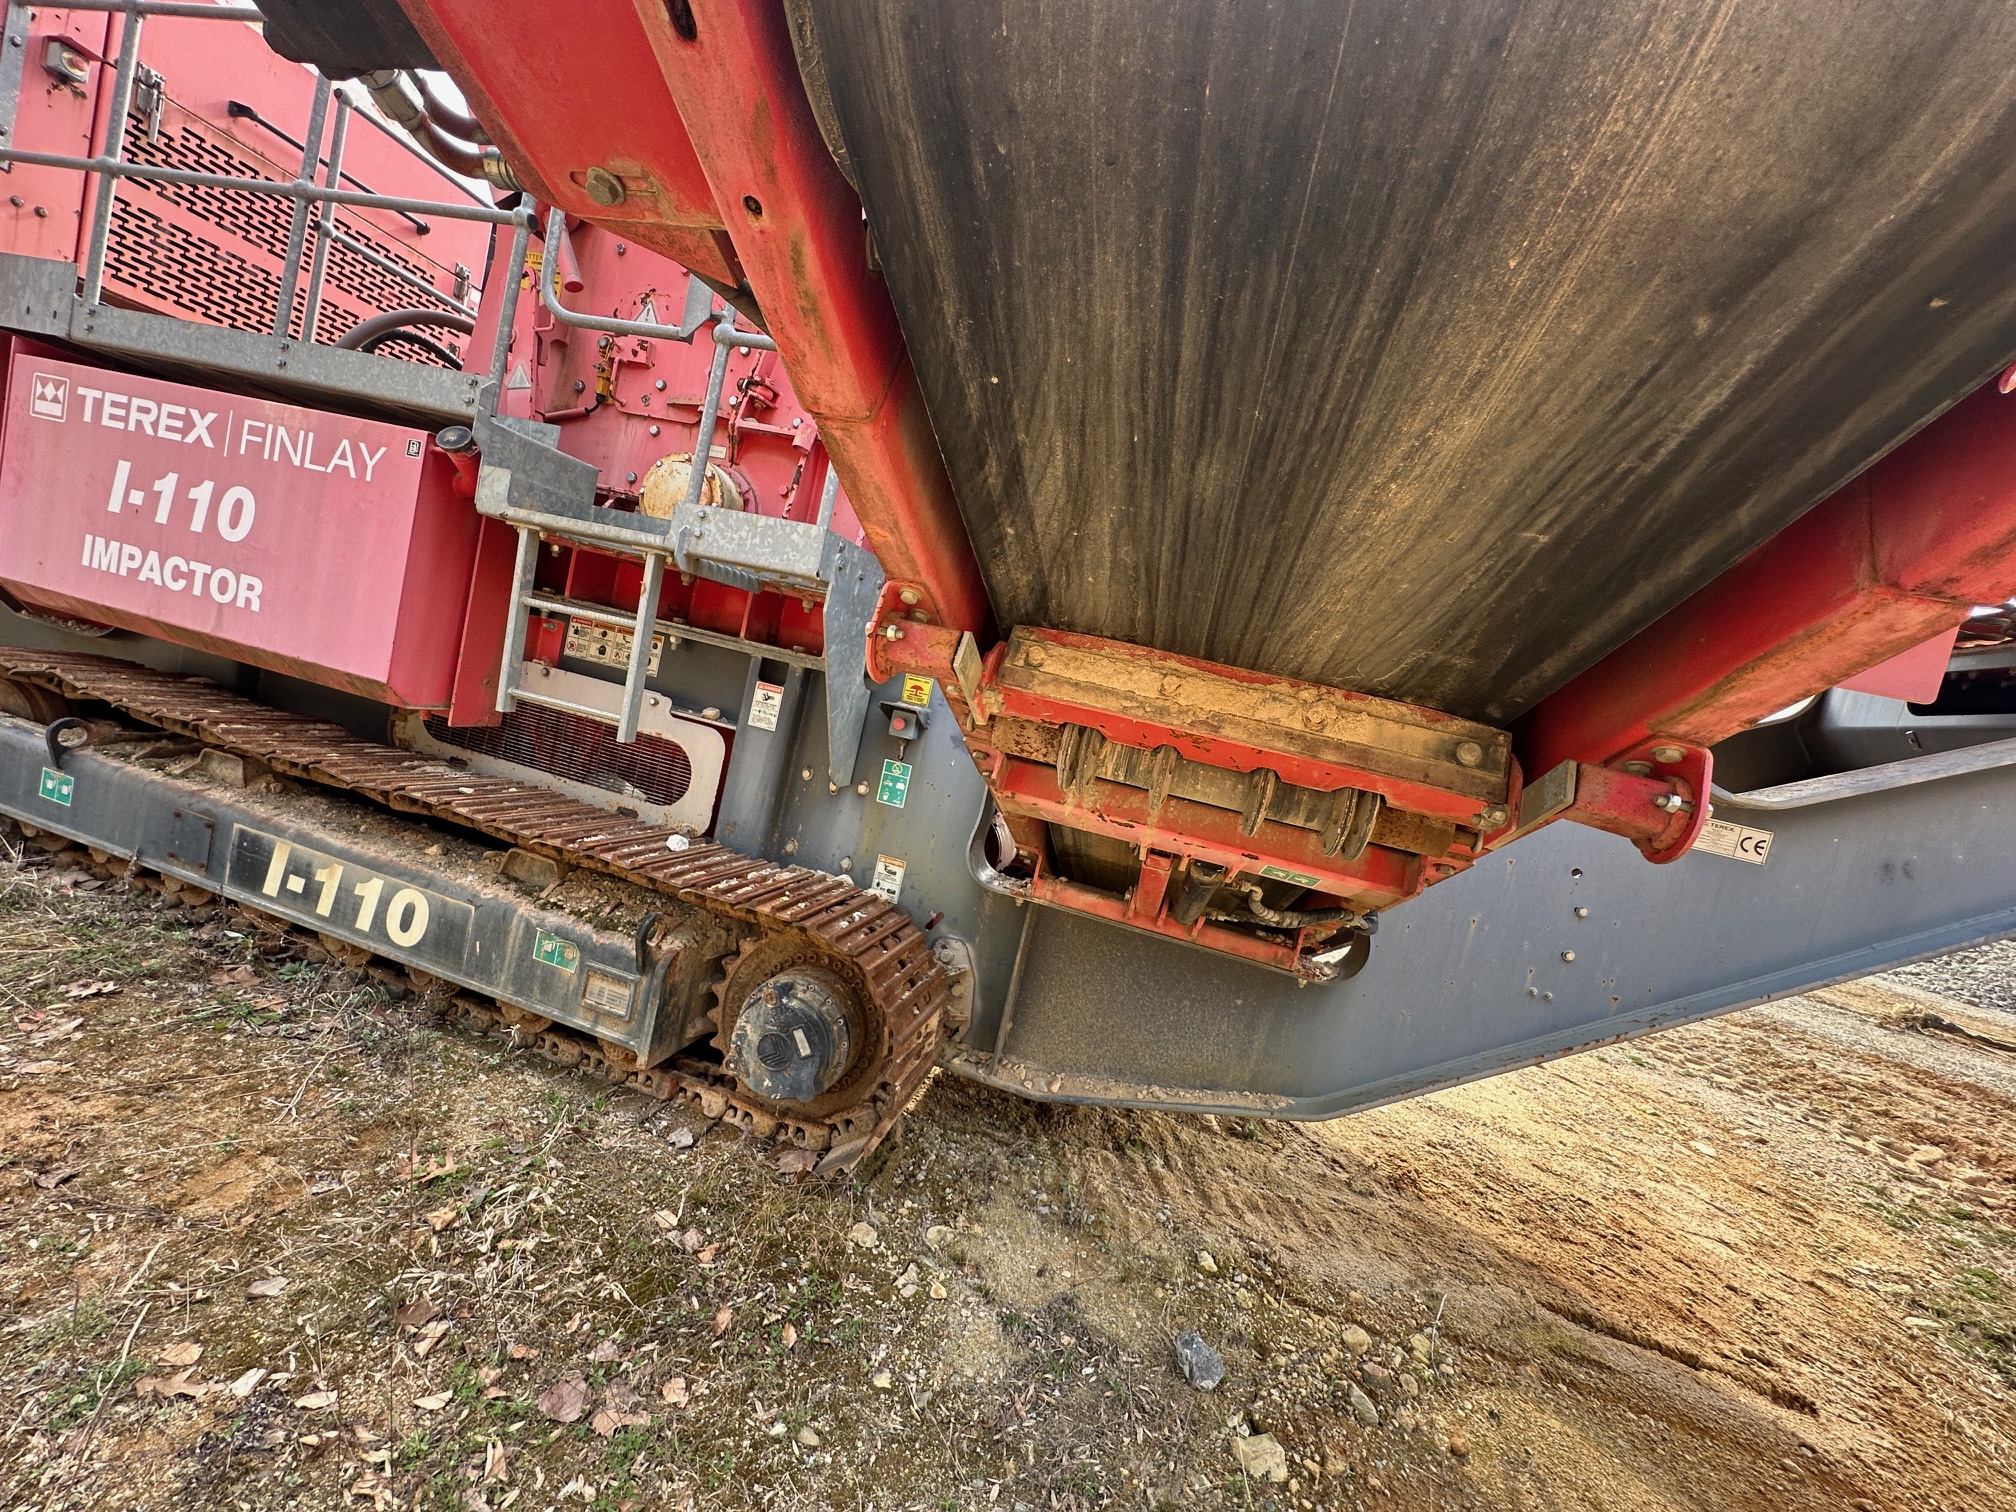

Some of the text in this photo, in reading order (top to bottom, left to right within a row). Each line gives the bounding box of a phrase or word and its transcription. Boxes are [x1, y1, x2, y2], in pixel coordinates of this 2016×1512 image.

[77, 387, 387, 482] TEREX FINLAY
[107, 459, 256, 543] I-110
[81, 534, 264, 613] IMPACTOR
[1711, 823, 1735, 832] TEREX
[1741, 837, 1766, 855] CE
[262, 841, 430, 948] I-110
